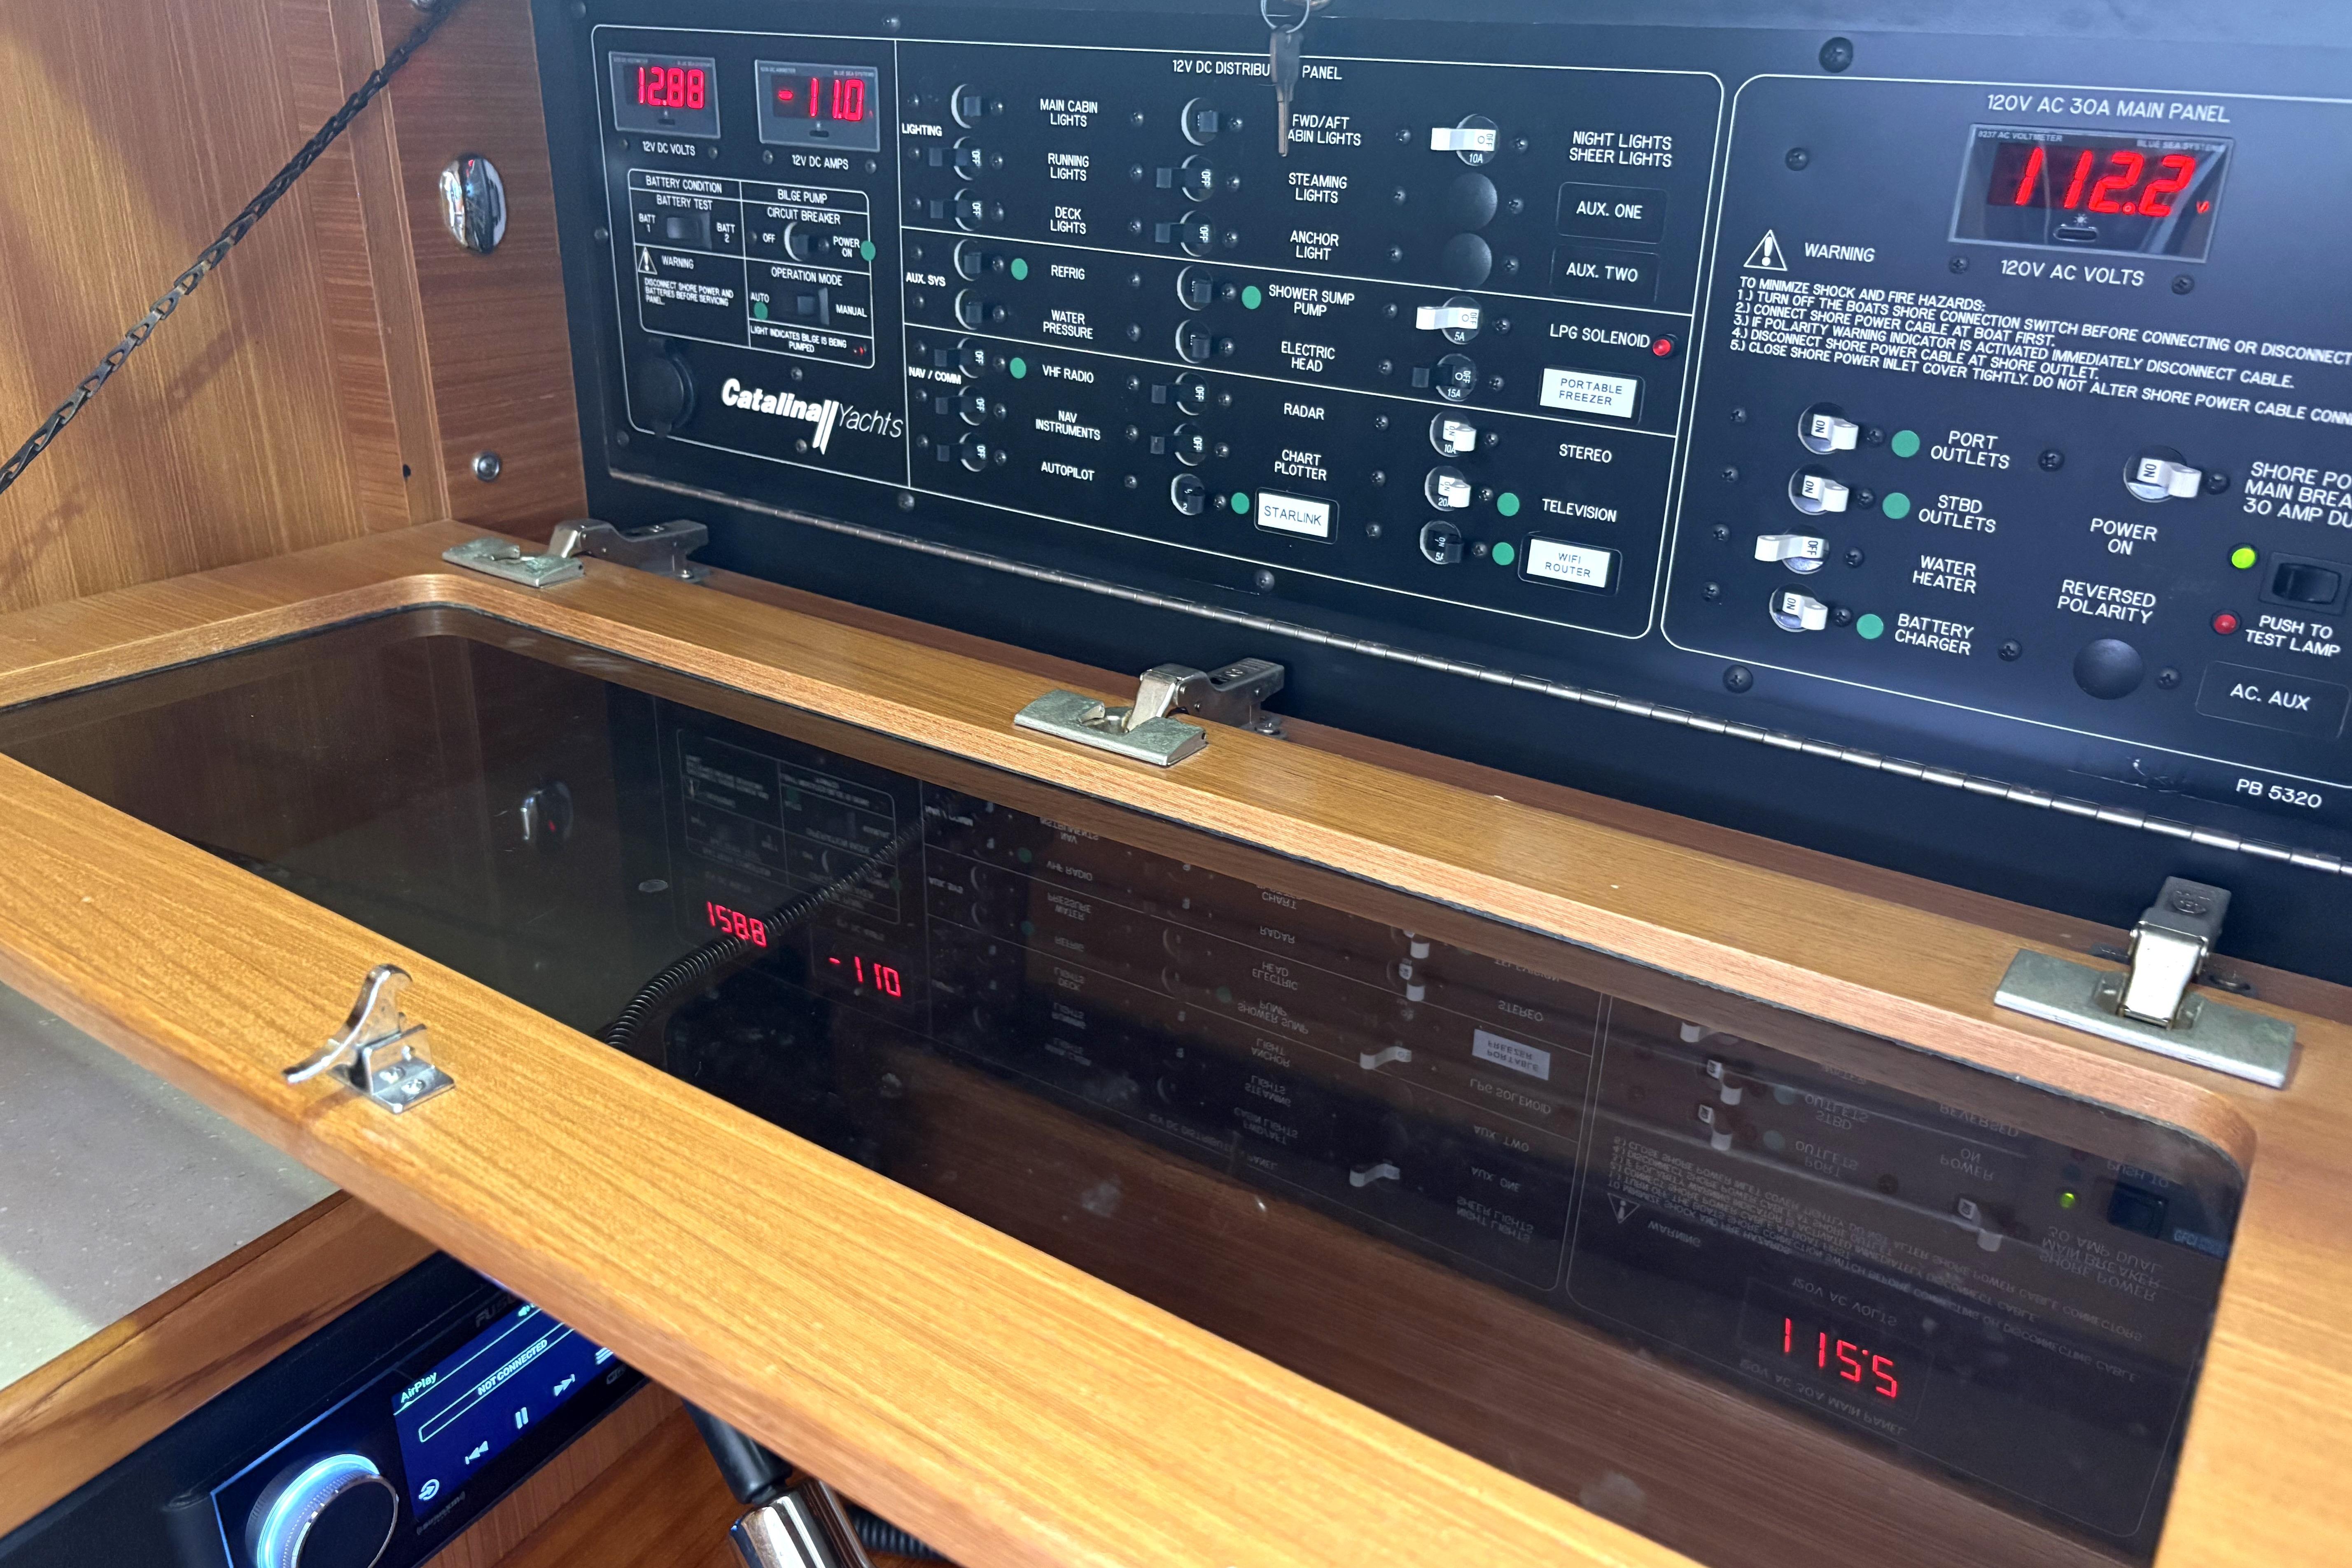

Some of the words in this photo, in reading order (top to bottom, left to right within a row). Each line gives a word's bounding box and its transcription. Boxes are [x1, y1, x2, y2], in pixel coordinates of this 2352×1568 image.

[1173, 60, 1192, 73] 12V
[1196, 61, 1212, 74] DC
[1216, 62, 1270, 77] DISTRIBU
[1302, 65, 1342, 80] PANEL
[1041, 98, 1064, 112] MAIN
[1068, 100, 1098, 114] CABIN
[1987, 94, 2032, 112] 120V
[2037, 96, 2065, 114] AC
[2070, 98, 2110, 116] 30A
[2116, 101, 2165, 119] MAIN
[2169, 103, 2230, 123] PANEL
[1050, 113, 1087, 127] LIGHTS
[1293, 114, 1349, 130] FWD/AFT
[902, 123, 942, 137] LIGHTING
[1288, 130, 1314, 143] ABIN
[1317, 131, 1361, 146] LIGHTS
[642, 141, 656, 152] 12V
[658, 142, 668, 153] DC
[670, 144, 695, 156] VOLTS
[1573, 131, 1614, 147] NIGHT
[1618, 133, 1672, 150] LIGHTS
[792, 155, 806, 166] 12V
[809, 156, 821, 168] DC
[824, 157, 849, 170] AMPS
[971, 151, 981, 166] OFF
[1048, 153, 1089, 168] RUNNING
[1469, 153, 1483, 164] 10A
[1569, 147, 1614, 164] SHEER
[1618, 152, 1672, 168] LIGHTS
[1050, 167, 1087, 182] LIGHTS
[1201, 169, 1211, 188] OFF
[1289, 173, 1347, 189] STEAMING
[2015, 147, 2195, 218] 112.2
[646, 175, 680, 189] BATTERY
[683, 180, 722, 193] CONDITION
[656, 194, 691, 208] BATTERY
[693, 198, 713, 210] TEST
[777, 189, 801, 202] BILGE
[804, 191, 827, 204] PUMP
[1295, 188, 1338, 203] LIGHTS
[639, 213, 656, 223] BATT
[767, 207, 798, 219] CIRCUIT
[801, 210, 840, 224] BREAKER
[1055, 206, 1081, 220] DECK
[1576, 201, 1609, 217] AUX.
[1615, 203, 1643, 219] ONE
[716, 222, 735, 233] BATT
[1050, 220, 1086, 234] LIGHTS
[724, 234, 730, 243] 2
[763, 233, 775, 243] OFF
[833, 236, 860, 248] POWER
[1290, 231, 1339, 247] ANCHOR
[842, 248, 852, 257] ON
[1296, 246, 1332, 261] LIGHT
[1805, 242, 1876, 263] WARNING
[662, 255, 694, 269] WARNING
[771, 267, 817, 282] OPERATION
[819, 274, 842, 286] MODE
[1051, 265, 1085, 280] REFRIG
[1566, 262, 1599, 278] AUX.
[1605, 266, 1638, 282] TWO
[2000, 259, 2046, 278] 120V
[2050, 264, 2076, 280] AC
[2084, 266, 2144, 287] VOLTS
[928, 276, 946, 287] SYS
[751, 292, 769, 303] AUTO
[1269, 285, 1318, 301] SHOWER
[1321, 291, 1355, 306] SUMP
[1740, 276, 1756, 288] TO
[1759, 278, 1810, 294] MINIMIZE
[1813, 283, 1856, 299] SHOCK
[1859, 288, 1885, 301] AND
[1888, 291, 1915, 305] FIRE
[1918, 294, 1986, 312] HAZARDS:
[836, 304, 867, 317] MANUAL
[1051, 309, 1085, 325] WATER
[1294, 302, 1327, 317] PUMP
[750, 325, 768, 335] LIGHT
[770, 328, 800, 341] INDICATES
[802, 333, 819, 344] BILGE
[821, 336, 827, 345] IS
[829, 338, 847, 348] BEING
[1043, 322, 1093, 340] PRESSURE
[1454, 331, 1465, 341] 5A
[1550, 324, 1578, 339] LPG
[1582, 327, 1650, 348] SOLENOID
[789, 341, 814, 352] PUMPED
[1281, 341, 1335, 360] ELECTRIC
[1042, 364, 1061, 378] VHF
[1064, 368, 1094, 383] RADIO
[1291, 358, 1323, 373] HEAD
[909, 367, 926, 378] NAV
[935, 371, 961, 385] COMM
[1463, 371, 1471, 383] OFF
[1447, 388, 1461, 398] 15A
[1560, 378, 1623, 395] PORTABLE
[721, 378, 823, 422] Catalina
[976, 398, 985, 412] OFF
[1559, 390, 1612, 406] FREEZER
[1058, 411, 1077, 423] NAV
[1284, 403, 1324, 420] RADAR
[839, 404, 903, 438] Yachts
[1815, 419, 1826, 434] ON
[1036, 419, 1101, 441] INSTRUMENTS
[1948, 430, 1998, 450] PORT
[1281, 449, 1321, 467] CHART
[1559, 443, 1612, 463] STEREO
[1930, 445, 2010, 469] OUTLETS
[1041, 461, 1094, 481] AUTOPILOT
[1274, 462, 1327, 481] PLOTTER
[2144, 463, 2157, 478] ON
[2251, 462, 2319, 485] SHORE
[2322, 471, 2352, 490] PO
[2245, 479, 2293, 500] MAIN
[2298, 487, 2352, 509] BREA
[1542, 498, 1617, 523] TELEVISION
[1938, 495, 1983, 514] STBD
[2243, 497, 2272, 515] 30
[2277, 503, 2323, 521] AMP
[2327, 510, 2352, 528] DU
[1264, 506, 1321, 526] STARLINK
[1918, 508, 1996, 533] OUTLETS
[2090, 518, 2158, 541] POWER
[1808, 540, 1819, 555] OFF
[2107, 539, 2133, 555] ON
[1558, 552, 1581, 565] WIFI
[1920, 555, 1976, 578] WATER
[1545, 562, 1591, 578] ROUTER
[1913, 571, 1976, 595] HEATER
[2062, 579, 2156, 608] REVERSED
[2057, 596, 2154, 624] POLARITY
[1897, 613, 1974, 639] BATTERY
[2259, 614, 2305, 636] PUSH
[2310, 623, 2333, 639] TO
[1895, 629, 1971, 656] CHARGER
[2245, 629, 2287, 647] TEST
[2289, 638, 2341, 658] LAMP
[2230, 684, 2262, 702] AC.
[2268, 690, 2310, 711] AUX
[2236, 778, 2263, 796] PB
[2268, 785, 2322, 808] 5320
[477, 1376, 497, 1395] NOT
[497, 1339, 548, 1381] CONNECTED
[400, 1372, 437, 1403] AirPlay
